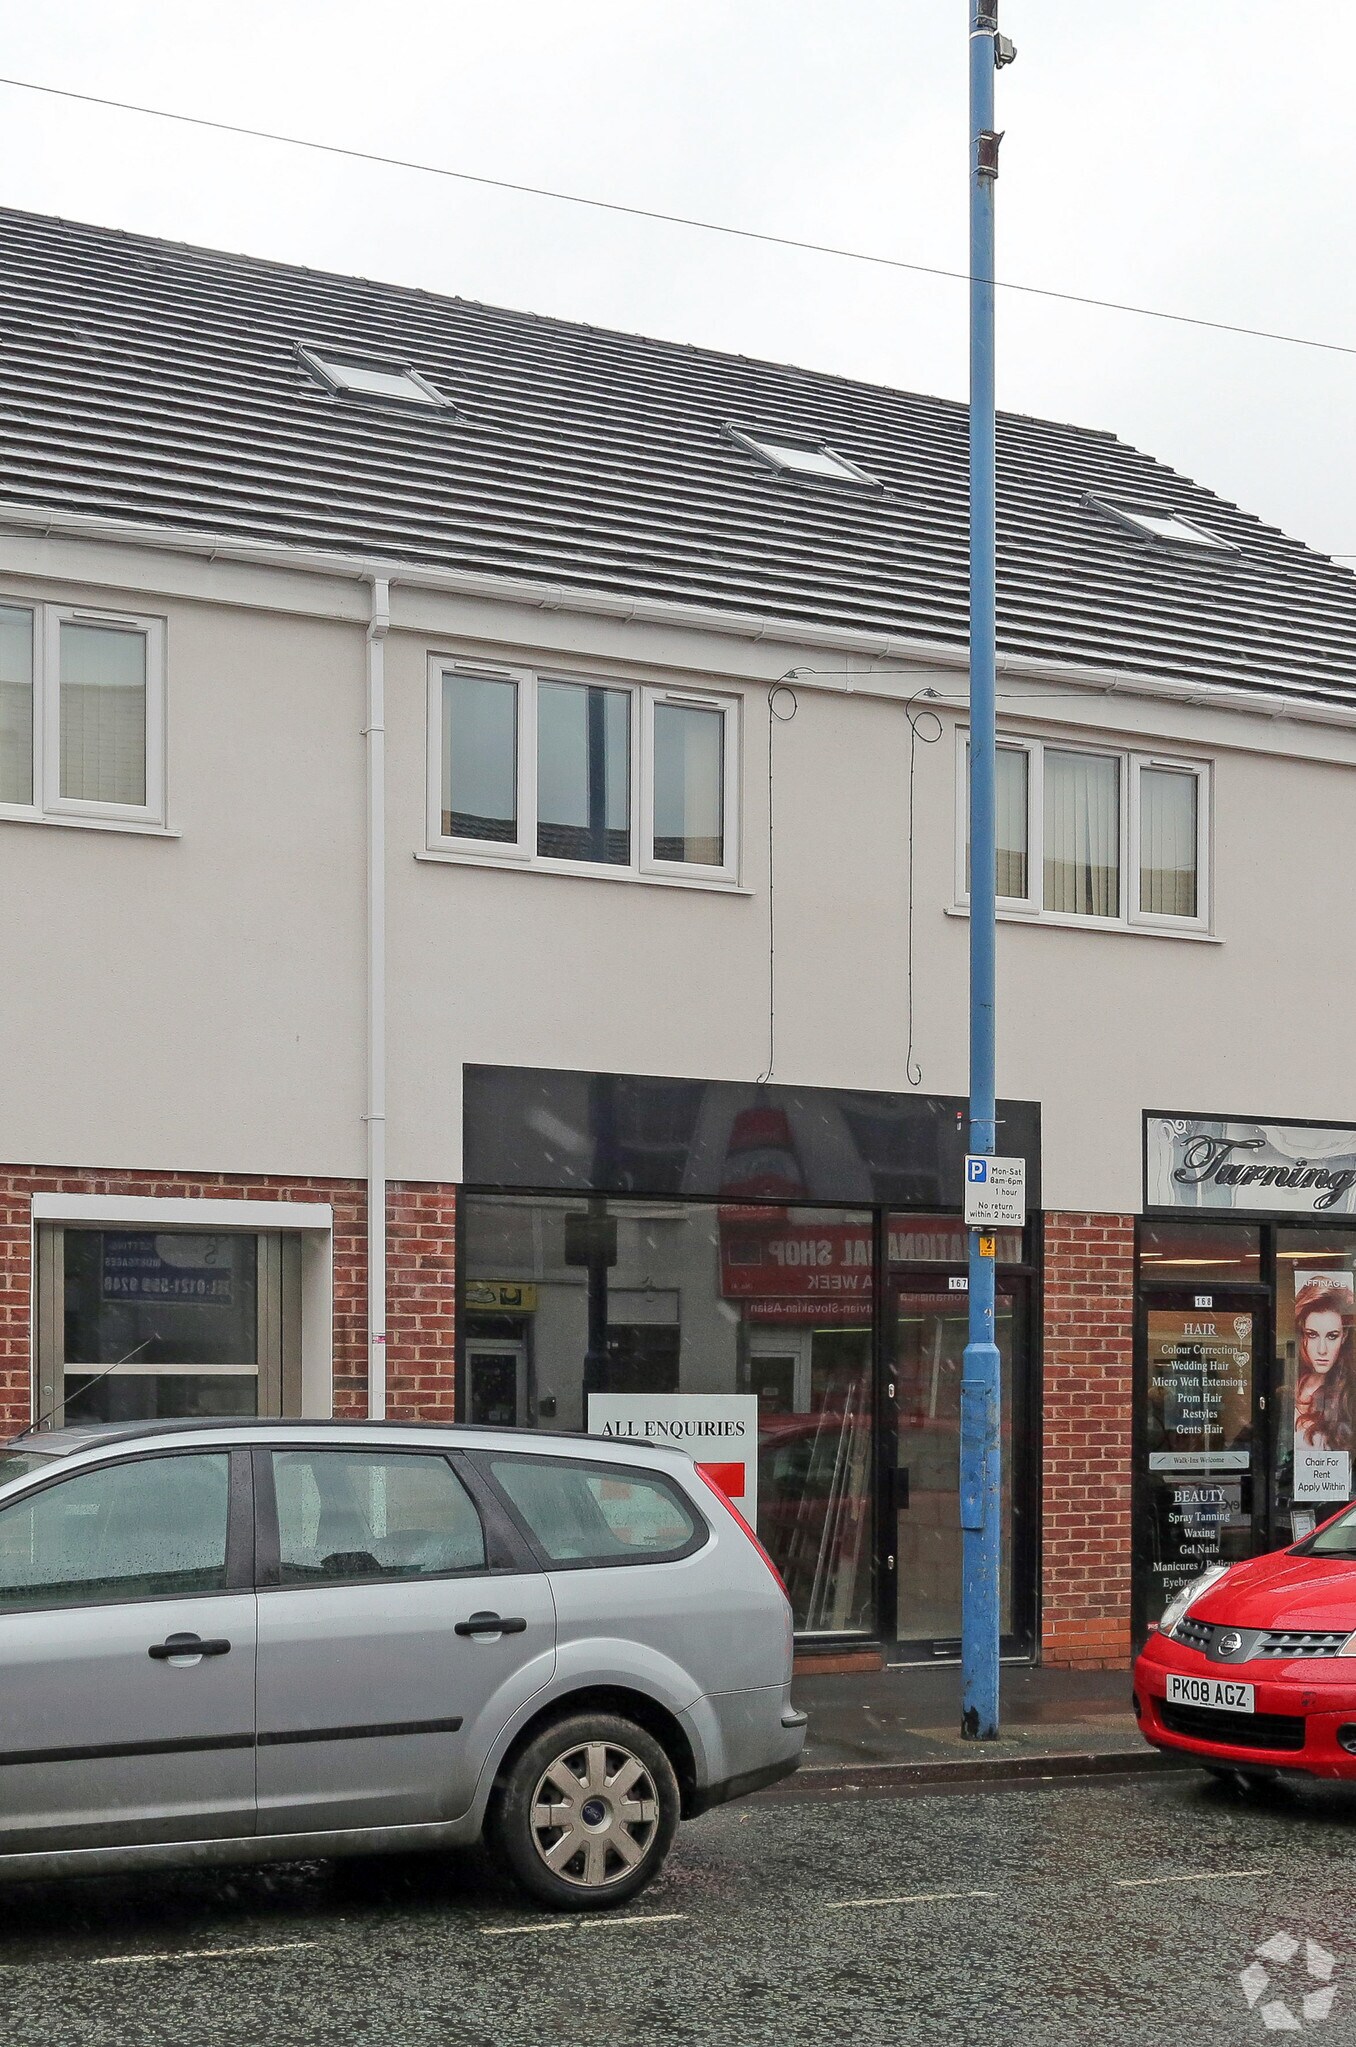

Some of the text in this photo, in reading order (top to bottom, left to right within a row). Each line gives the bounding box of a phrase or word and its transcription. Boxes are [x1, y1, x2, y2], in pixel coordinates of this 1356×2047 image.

[972, 1162, 983, 1180] P
[992, 1167, 1022, 1176] Mon-Sat
[1174, 1135, 1356, 1209] Turning
[990, 1177, 1023, 1186] 8am-6pm
[1002, 1188, 1017, 1196] hour
[969, 1211, 1022, 1220] within 2 hours
[986, 1239, 993, 1249] 2
[951, 1279, 967, 1288] 167
[1303, 1280, 1346, 1288] AFFINAGE
[1196, 1298, 1212, 1306] 168
[1183, 1323, 1217, 1335] HAIR
[1161, 1344, 1238, 1355] Colour Correction
[1171, 1361, 1230, 1373] Wedding Hair
[1152, 1377, 1248, 1387] Micro Weft Extensions
[1177, 1393, 1223, 1403] Prom Hair
[1182, 1409, 1218, 1420] Restyles
[602, 1421, 745, 1439] ALL ENQUIRIES
[1176, 1424, 1224, 1434] Gents Hair
[1305, 1457, 1340, 1467] Chair For
[1313, 1470, 1331, 1479] Rent
[1298, 1482, 1346, 1492] Apply Within
[1174, 1489, 1226, 1502] BEAUTY
[1168, 1511, 1231, 1524] Spray Tanning
[1184, 1528, 1216, 1539] Waxing
[1179, 1544, 1220, 1554] Gel Nails
[1153, 1561, 1199, 1572] Manicures
[1172, 1677, 1247, 1708] PK08 AGZ
